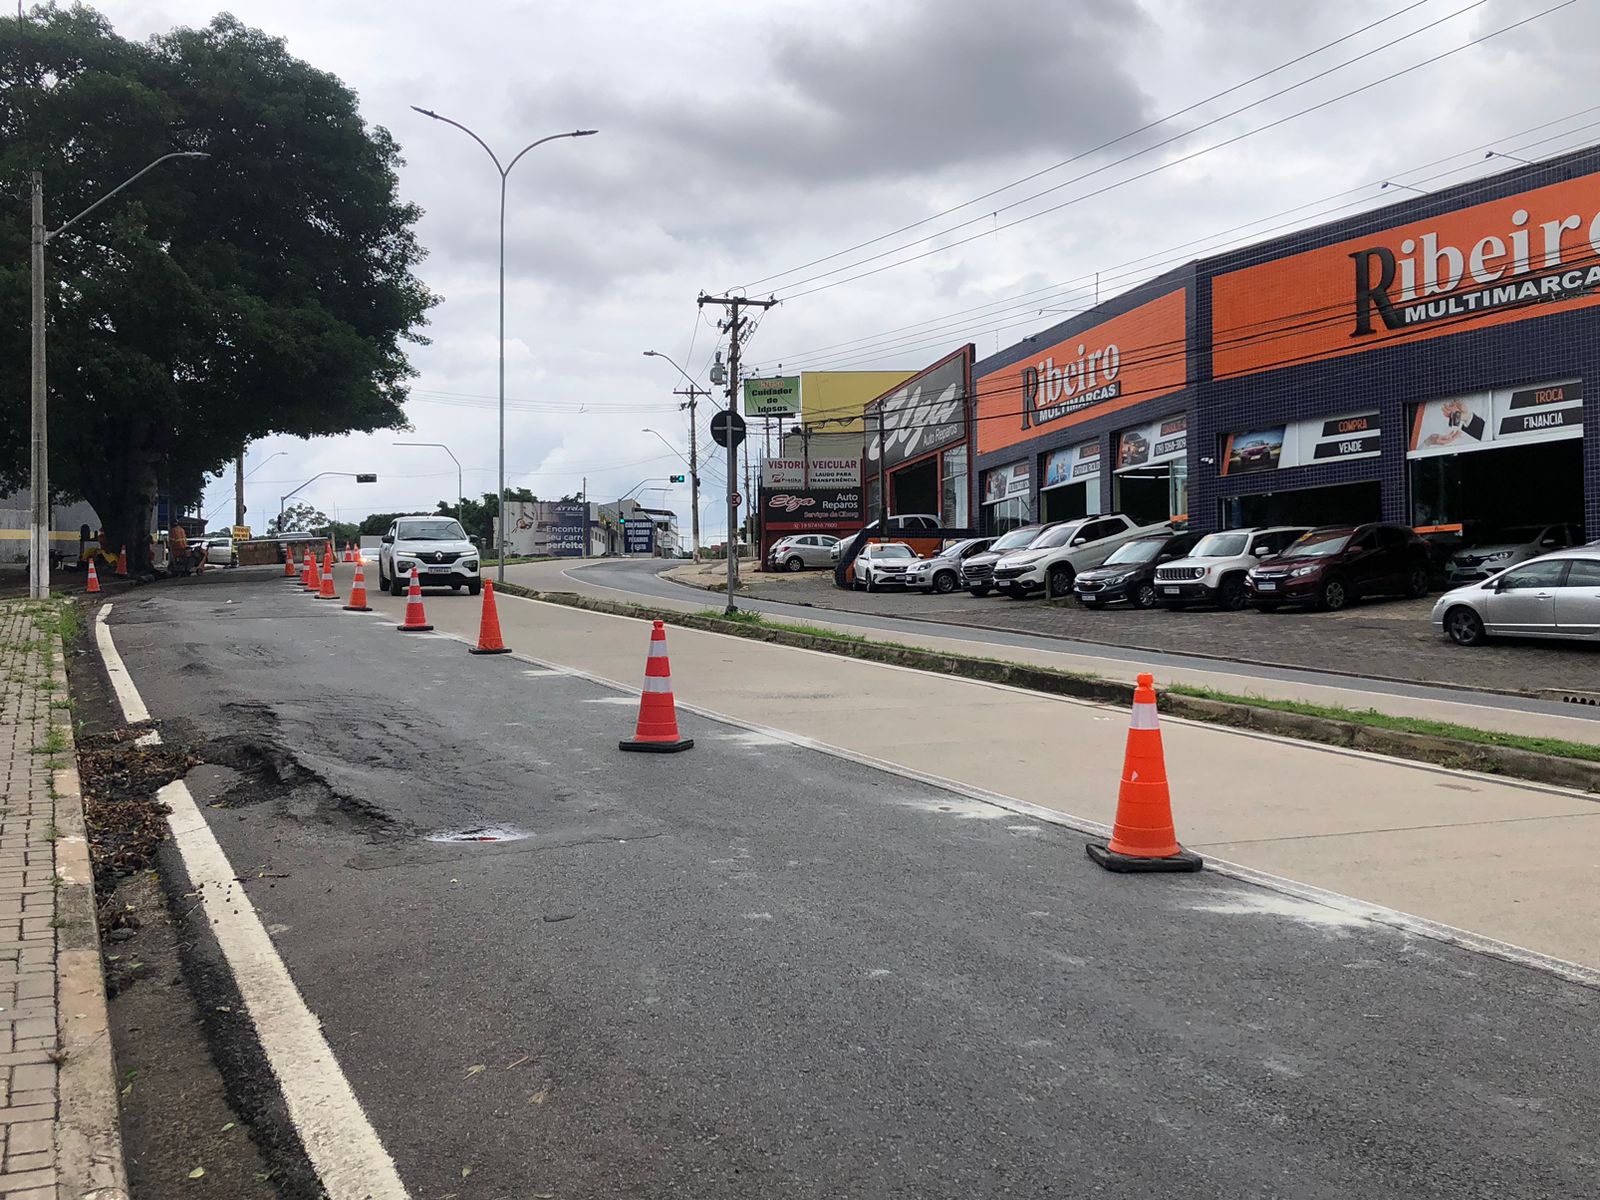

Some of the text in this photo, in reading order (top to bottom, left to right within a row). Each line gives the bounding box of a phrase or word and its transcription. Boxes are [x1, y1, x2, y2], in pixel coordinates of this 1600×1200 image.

[1349, 209, 1600, 338] Ribeir
[752, 388, 792, 396] Cuidador
[1021, 344, 1119, 431] Ribeiro
[1040, 384, 1116, 421] MULTIMARCAS
[1535, 389, 1563, 403] TROCA
[1339, 419, 1368, 432] COMPRA
[1524, 412, 1563, 429] FINANCIA
[1339, 440, 1362, 453] VENDE
[813, 461, 857, 469] VEICULAR
[769, 494, 816, 512] Elza
[836, 493, 858, 501] Auto
[822, 501, 858, 510] Reparos
[546, 541, 584, 550] perfeito
